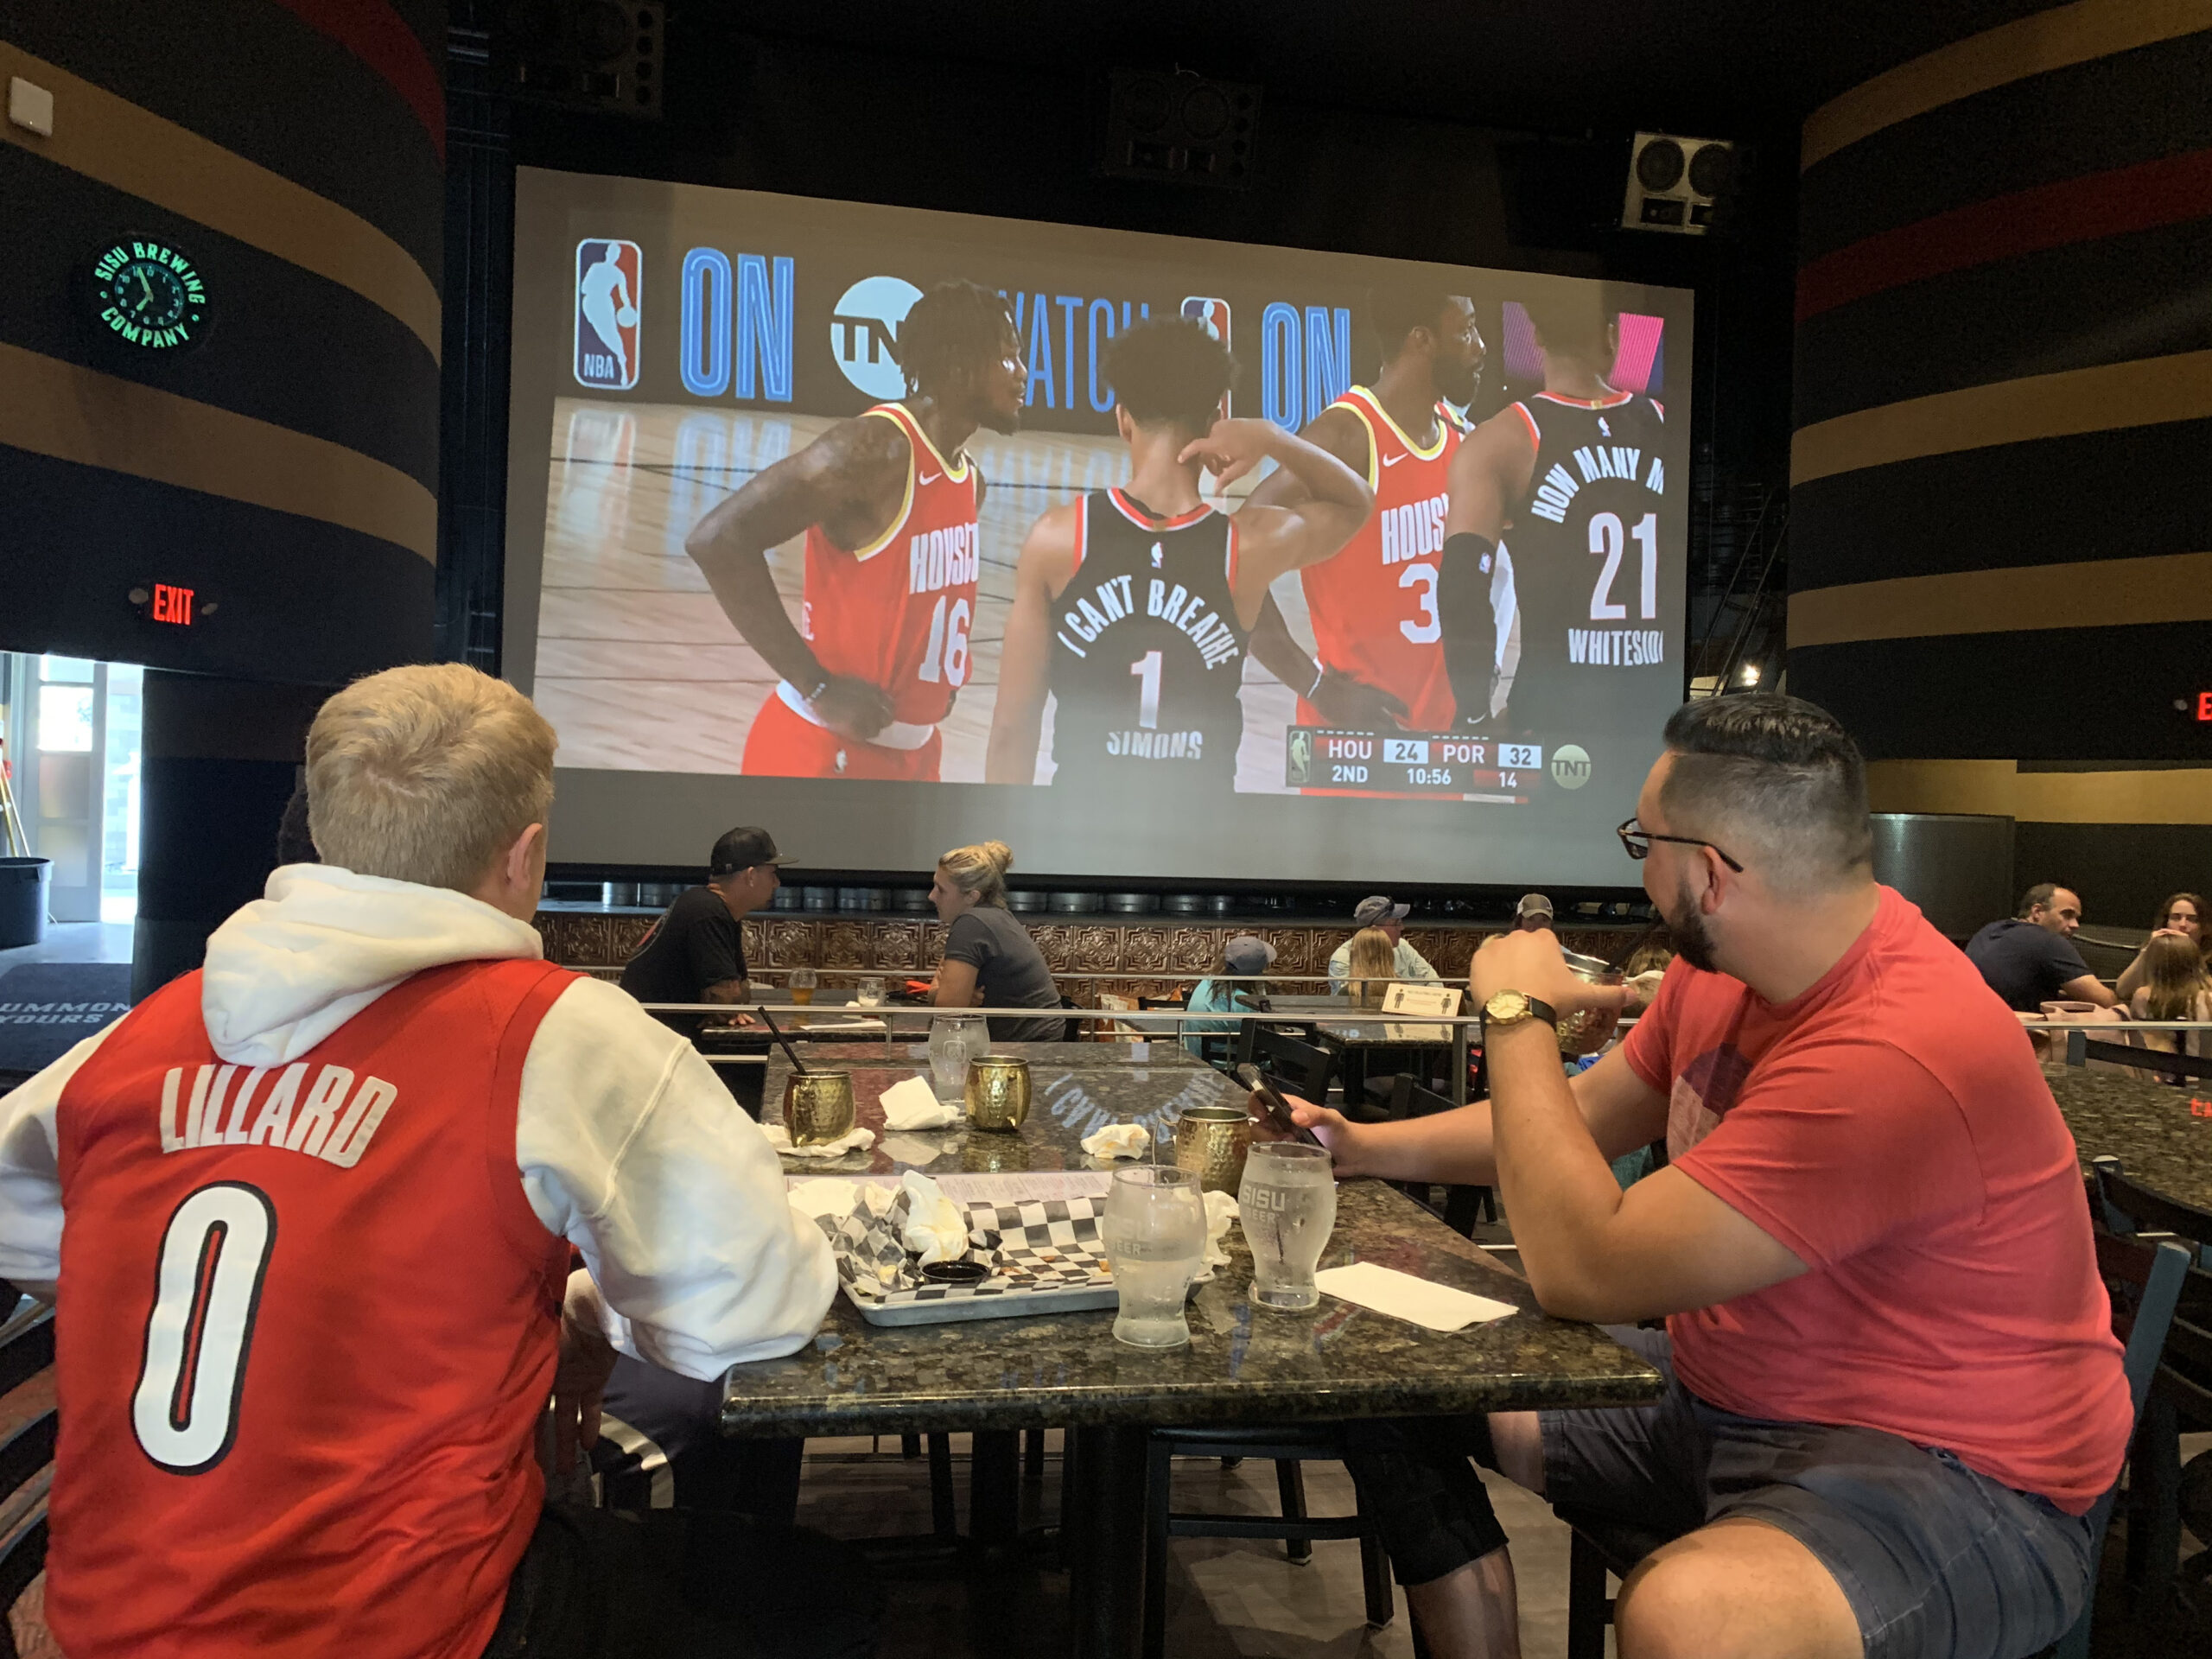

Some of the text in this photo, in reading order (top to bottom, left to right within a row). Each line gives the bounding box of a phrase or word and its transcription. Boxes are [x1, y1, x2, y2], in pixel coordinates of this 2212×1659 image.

[94, 242, 206, 304] SISU BREWING
[101, 306, 189, 348] COMPANY
[680, 246, 794, 403] ON
[998, 289, 1149, 412] ATC
[583, 353, 614, 379] NBA
[1262, 302, 1351, 434] ON
[1530, 462, 1580, 524] HOW
[1573, 445, 1640, 484] MANY
[1381, 492, 1449, 565] HOUS
[1587, 512, 1657, 620] 21
[153, 583, 194, 626] EXIT
[1057, 631, 1086, 658] I
[1147, 578, 1239, 671] BREATHE
[1398, 563, 1442, 644] 3
[918, 594, 970, 687] 16
[1567, 628, 1664, 666] WHITESID
[1131, 651, 1162, 729] 1
[1106, 730, 1203, 760] SIMONS
[1328, 739, 1532, 766] HOU 24 POR 32
[1332, 766, 1517, 788] 2ND 10:56 14
[0, 1014, 104, 1024] YOURS
[159, 1062, 397, 1168] LILLARD
[1242, 1185, 1286, 1211] SISU
[1110, 1240, 1141, 1255] EER
[130, 1180, 277, 1477] 0
